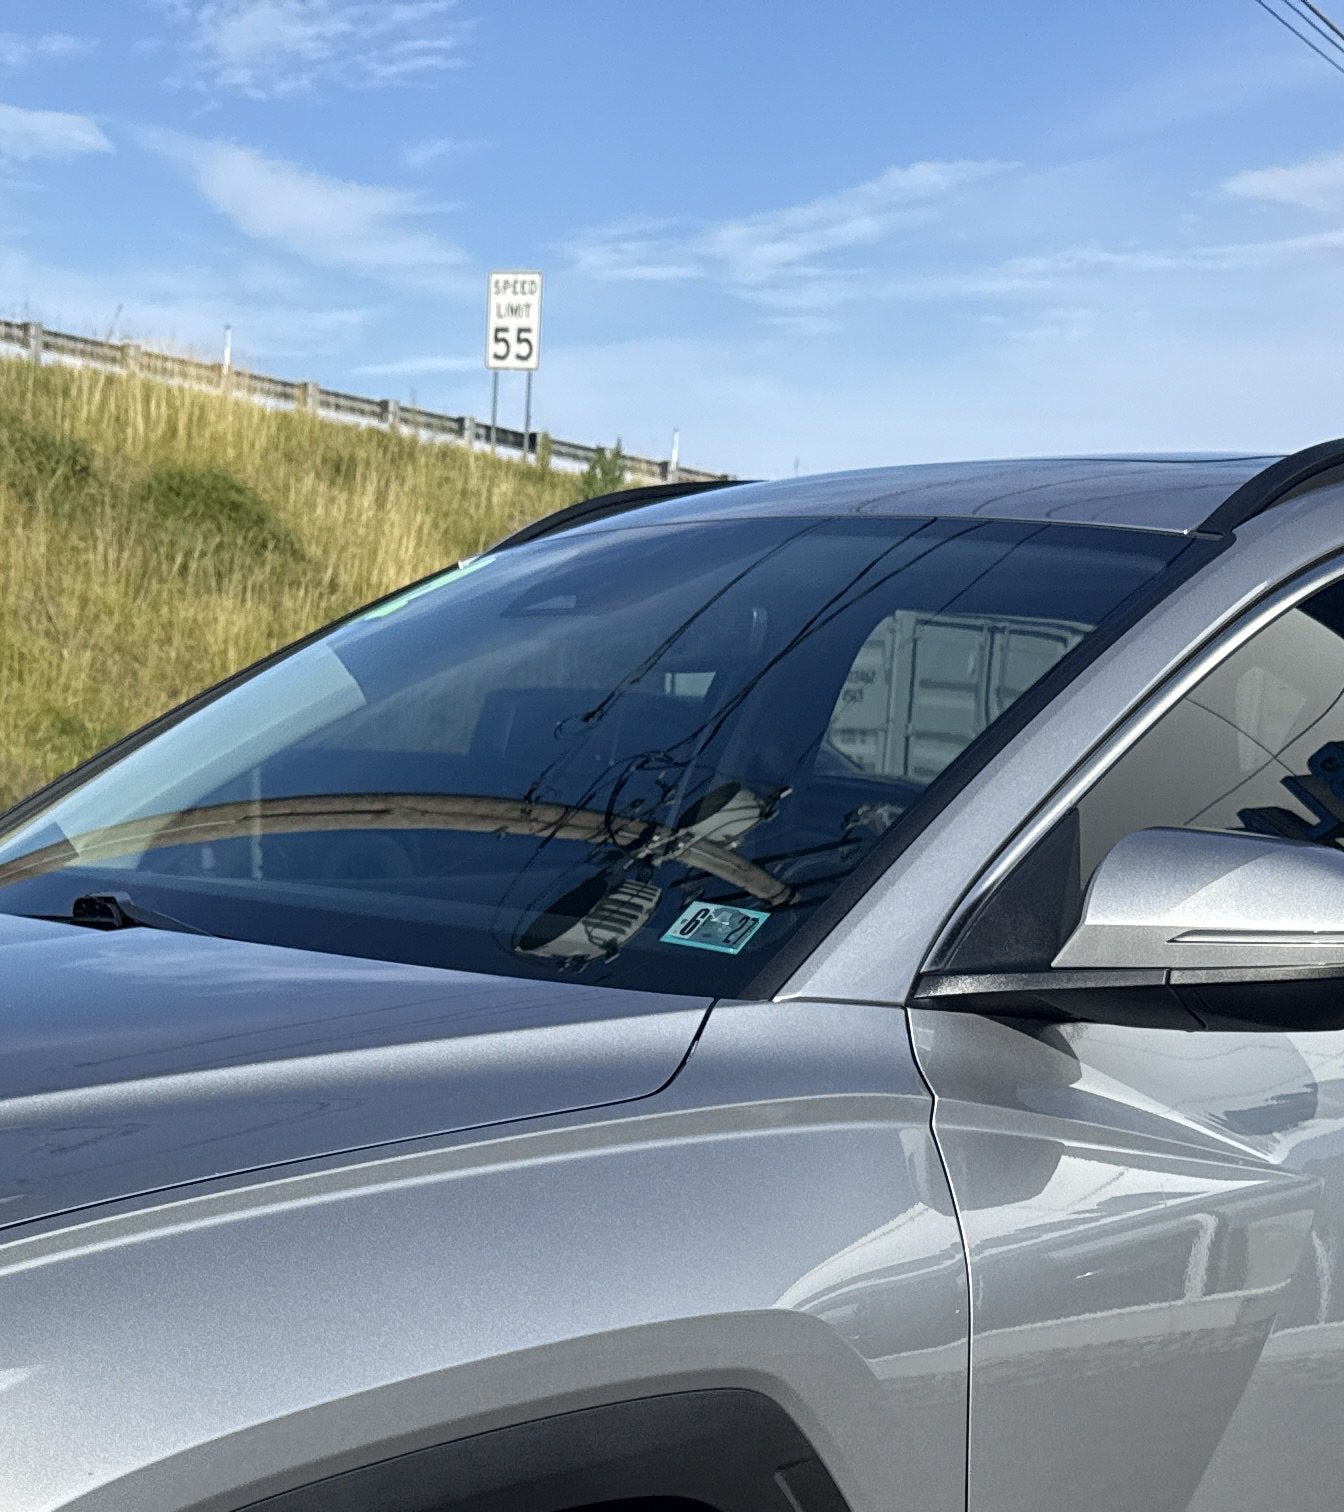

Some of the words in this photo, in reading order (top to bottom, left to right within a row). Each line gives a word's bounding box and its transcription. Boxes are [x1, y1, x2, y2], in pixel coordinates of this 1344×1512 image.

[494, 279, 537, 295] SPEED
[496, 303, 531, 318] LIMIT
[493, 327, 533, 361] 55
